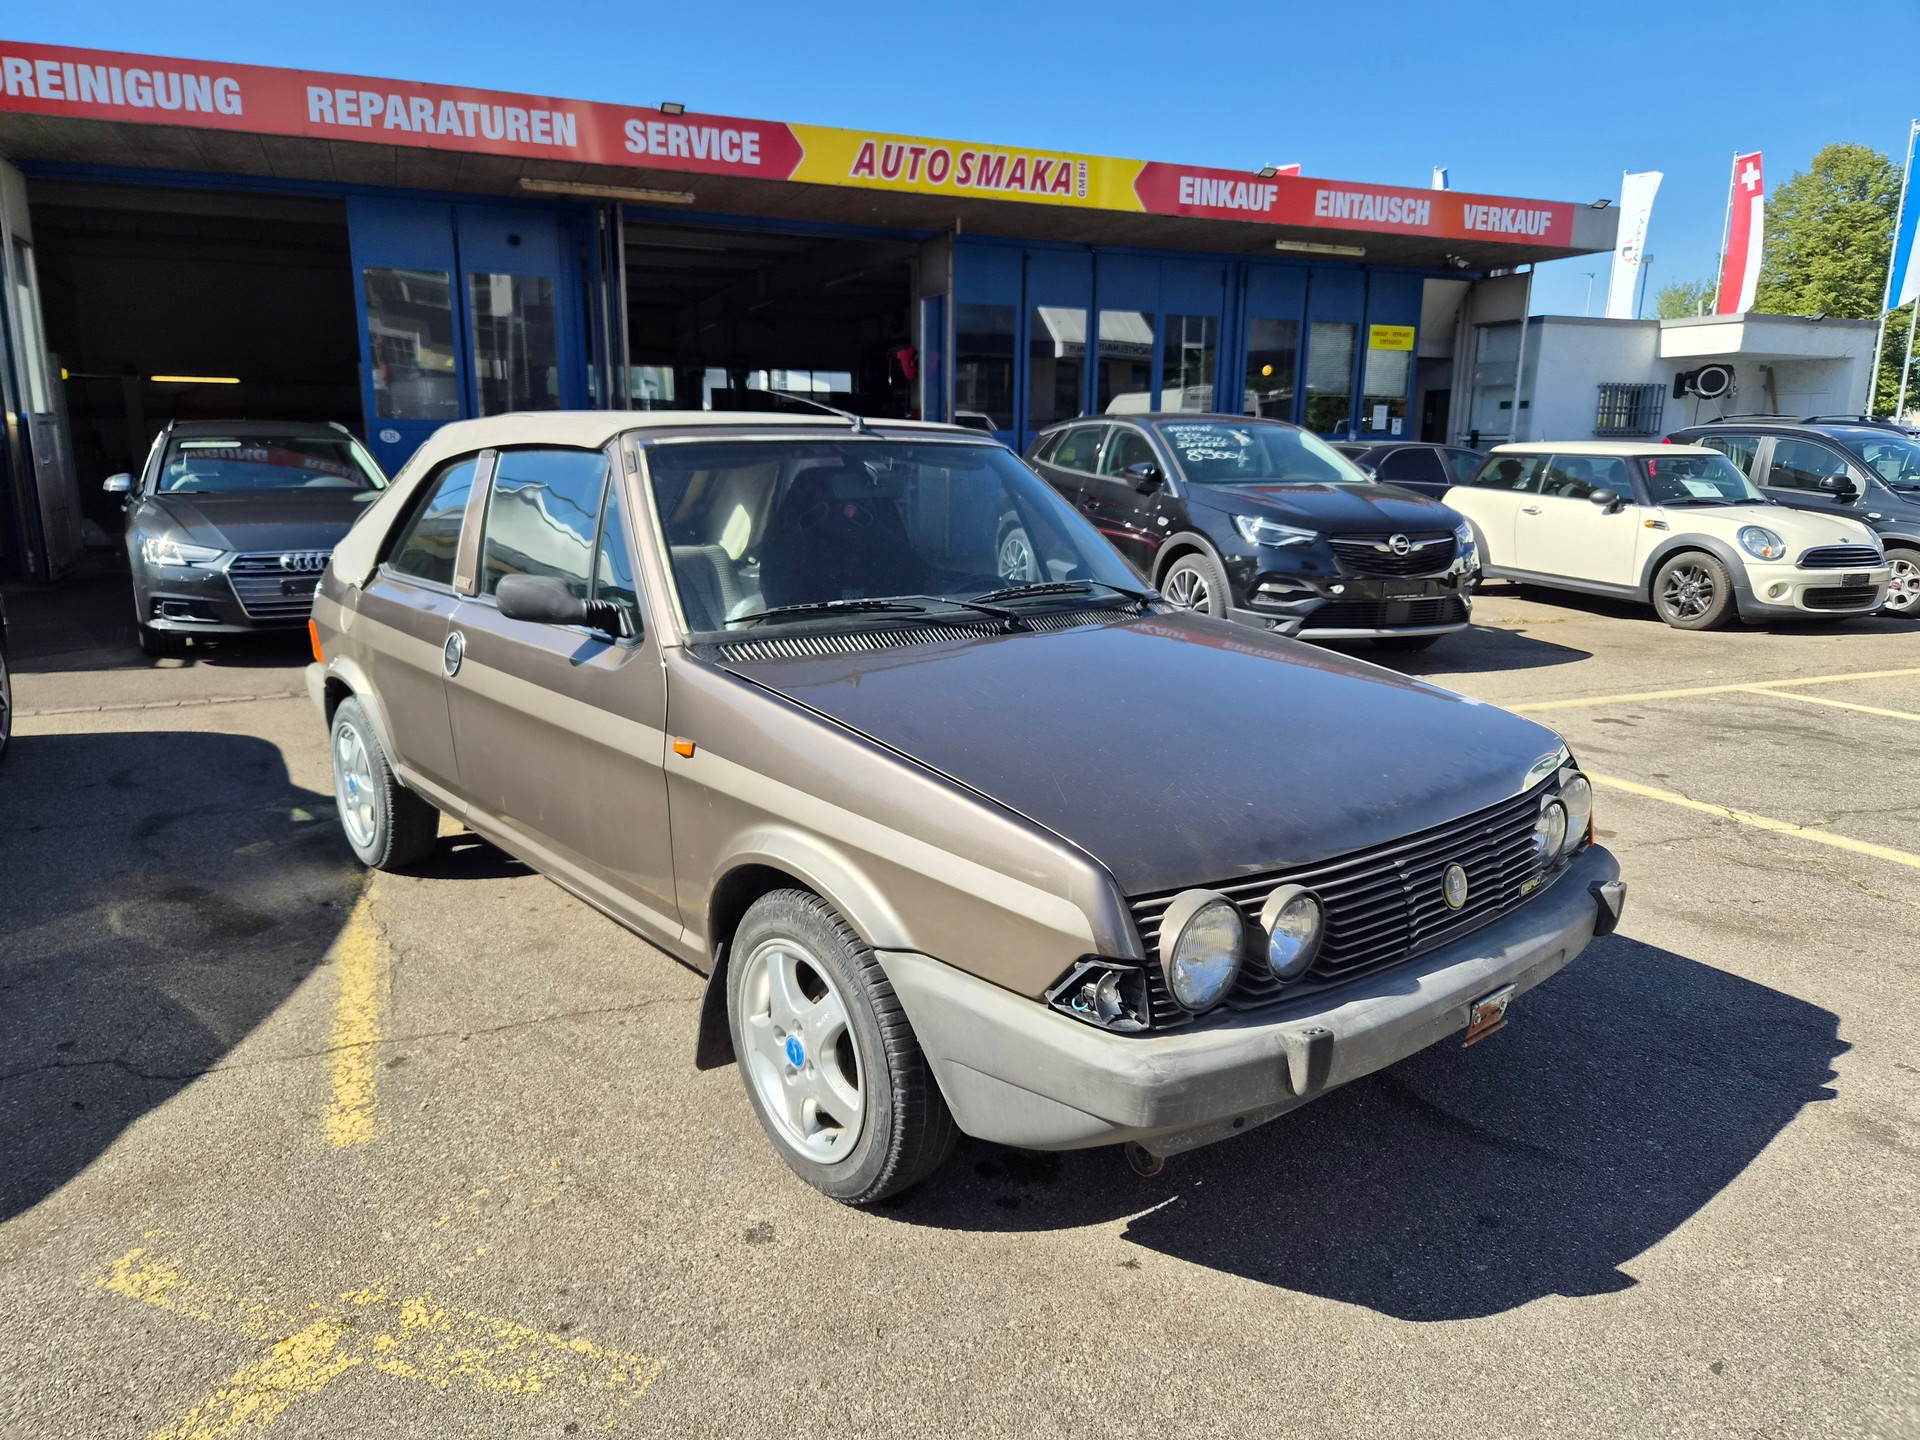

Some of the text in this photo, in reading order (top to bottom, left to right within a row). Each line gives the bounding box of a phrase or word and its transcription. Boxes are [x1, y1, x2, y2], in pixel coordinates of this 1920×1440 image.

[0, 56, 243, 115] REINIGUNG
[306, 86, 577, 147] REPARATUREN
[624, 118, 761, 165] SERVICE
[1077, 162, 1087, 197] GMBH
[1179, 176, 1278, 212] EINKAUF
[1315, 189, 1430, 226] EINTAUSCH
[1463, 204, 1552, 236] VERKAUF
